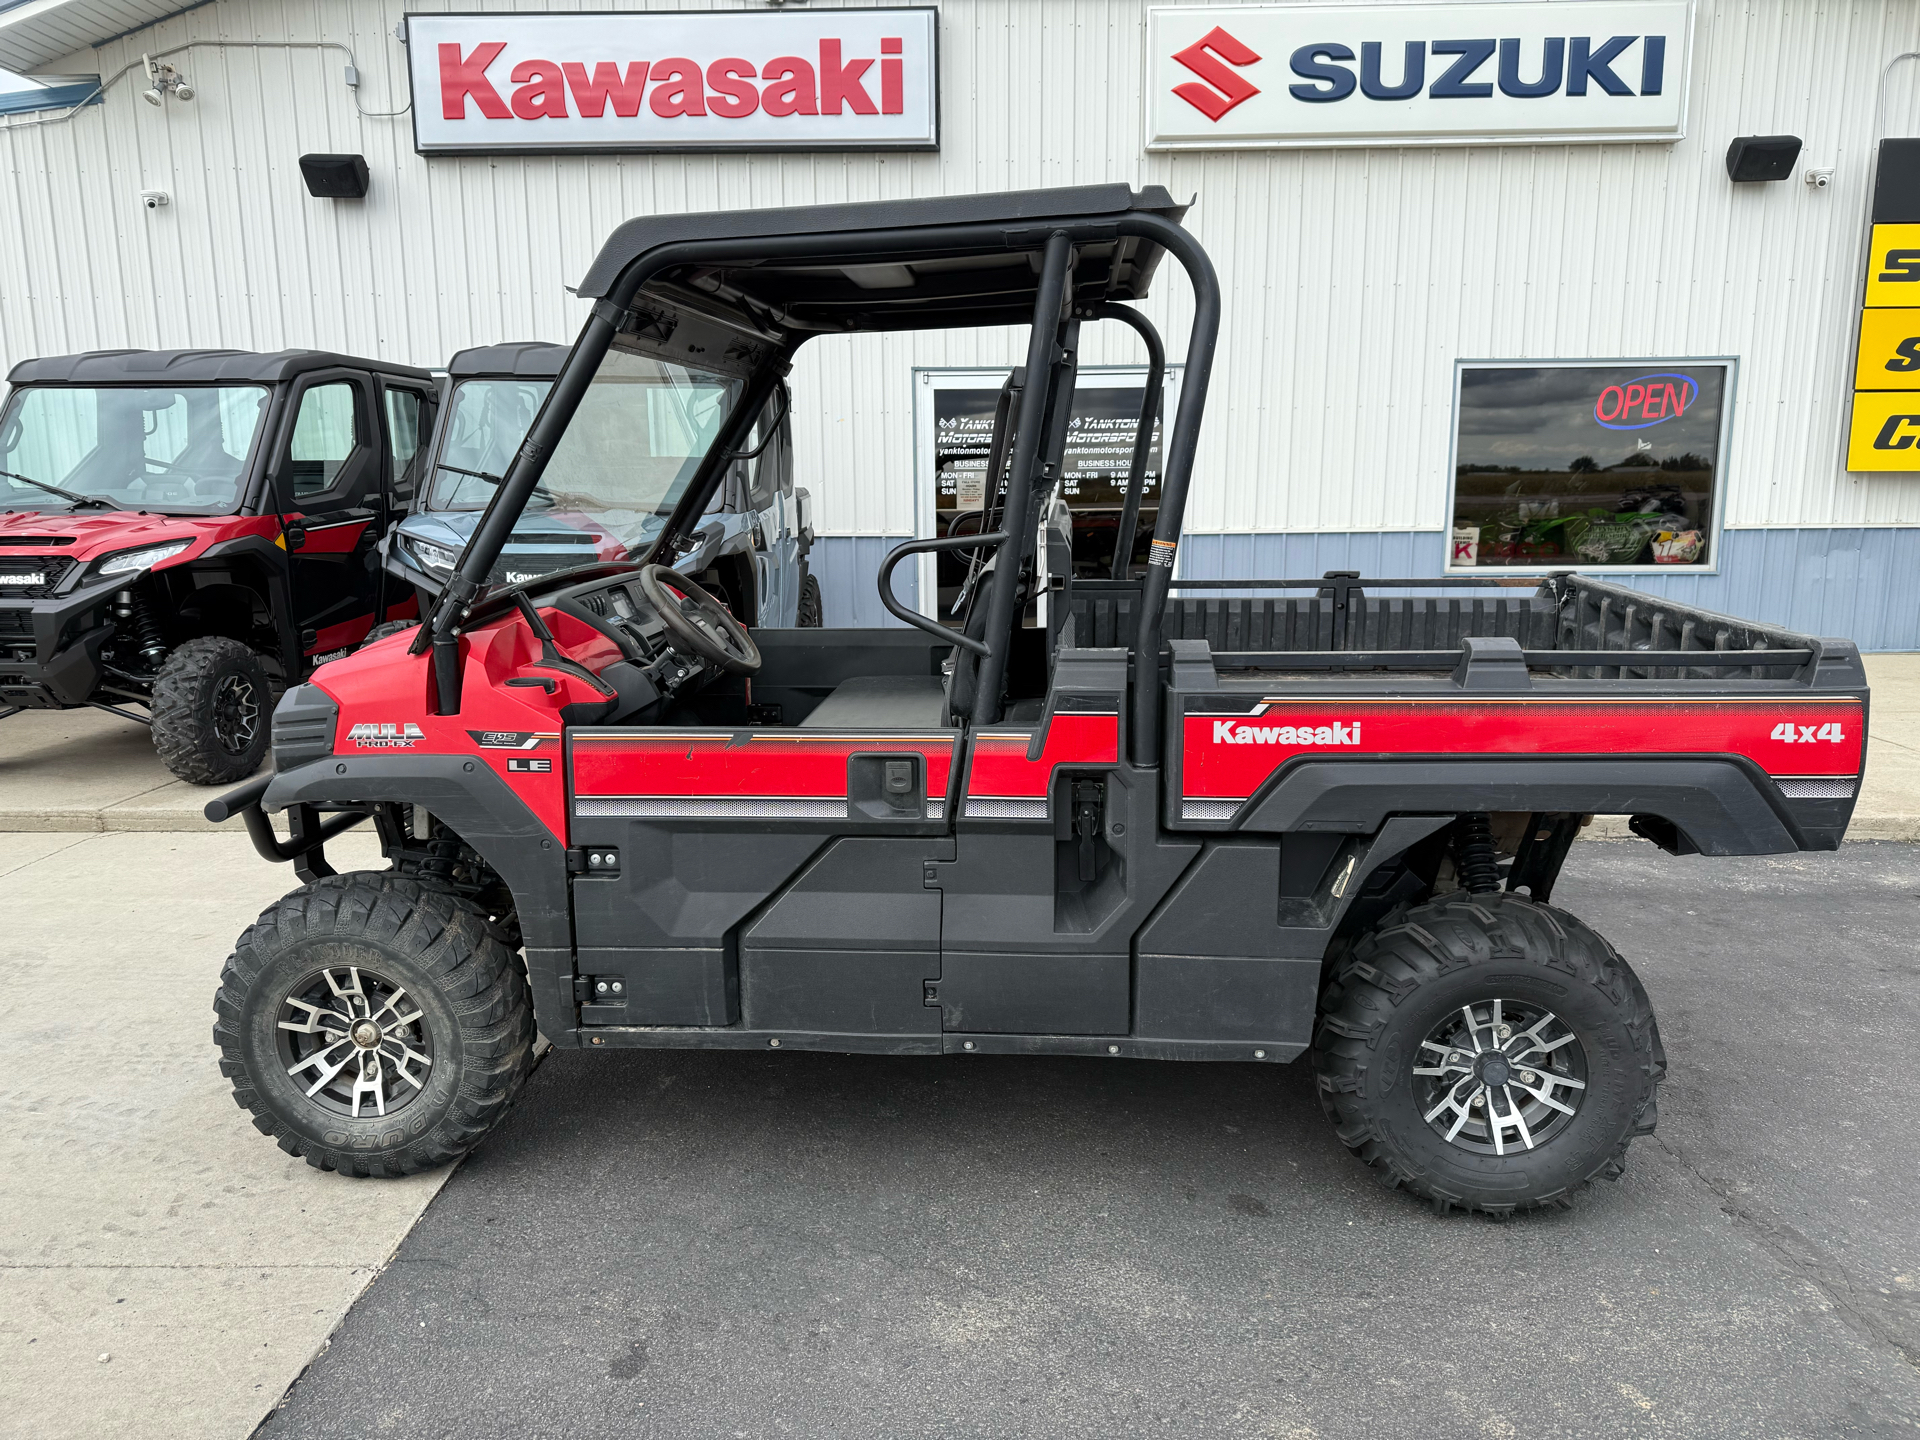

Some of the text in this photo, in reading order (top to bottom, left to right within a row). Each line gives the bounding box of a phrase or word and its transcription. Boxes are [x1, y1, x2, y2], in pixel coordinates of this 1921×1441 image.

[1288, 35, 1667, 103] SUZUKI
[438, 37, 904, 120] Kawasaki
[1596, 382, 1689, 421] OPEN
[960, 417, 994, 429] YANKT
[1084, 417, 1140, 429] YANKTON
[938, 431, 993, 443] MOTORS
[1066, 431, 1160, 442] MOTORSPOS
[1873, 414, 1920, 450] C
[954, 460, 988, 468] BUSINESS
[941, 471, 957, 479] MON
[963, 471, 975, 479] FRI
[1064, 471, 1081, 479] MON
[1086, 471, 1098, 479] FRI
[1110, 471, 1116, 479] 9
[1144, 470, 1156, 478] PM
[1110, 479, 1116, 487] 9
[1144, 478, 1156, 486] PM
[941, 487, 957, 495] SUN
[1064, 487, 1080, 495] SUN
[1454, 542, 1560, 559] KYMCO
[0, 572, 45, 585] wasaki
[312, 647, 347, 667] Kawasaki
[346, 723, 426, 741] MULE
[1213, 720, 1361, 745] Kawasaki
[1770, 723, 1845, 743] 4x4
[508, 760, 551, 771] LE
[322, 1112, 428, 1149] DURO
